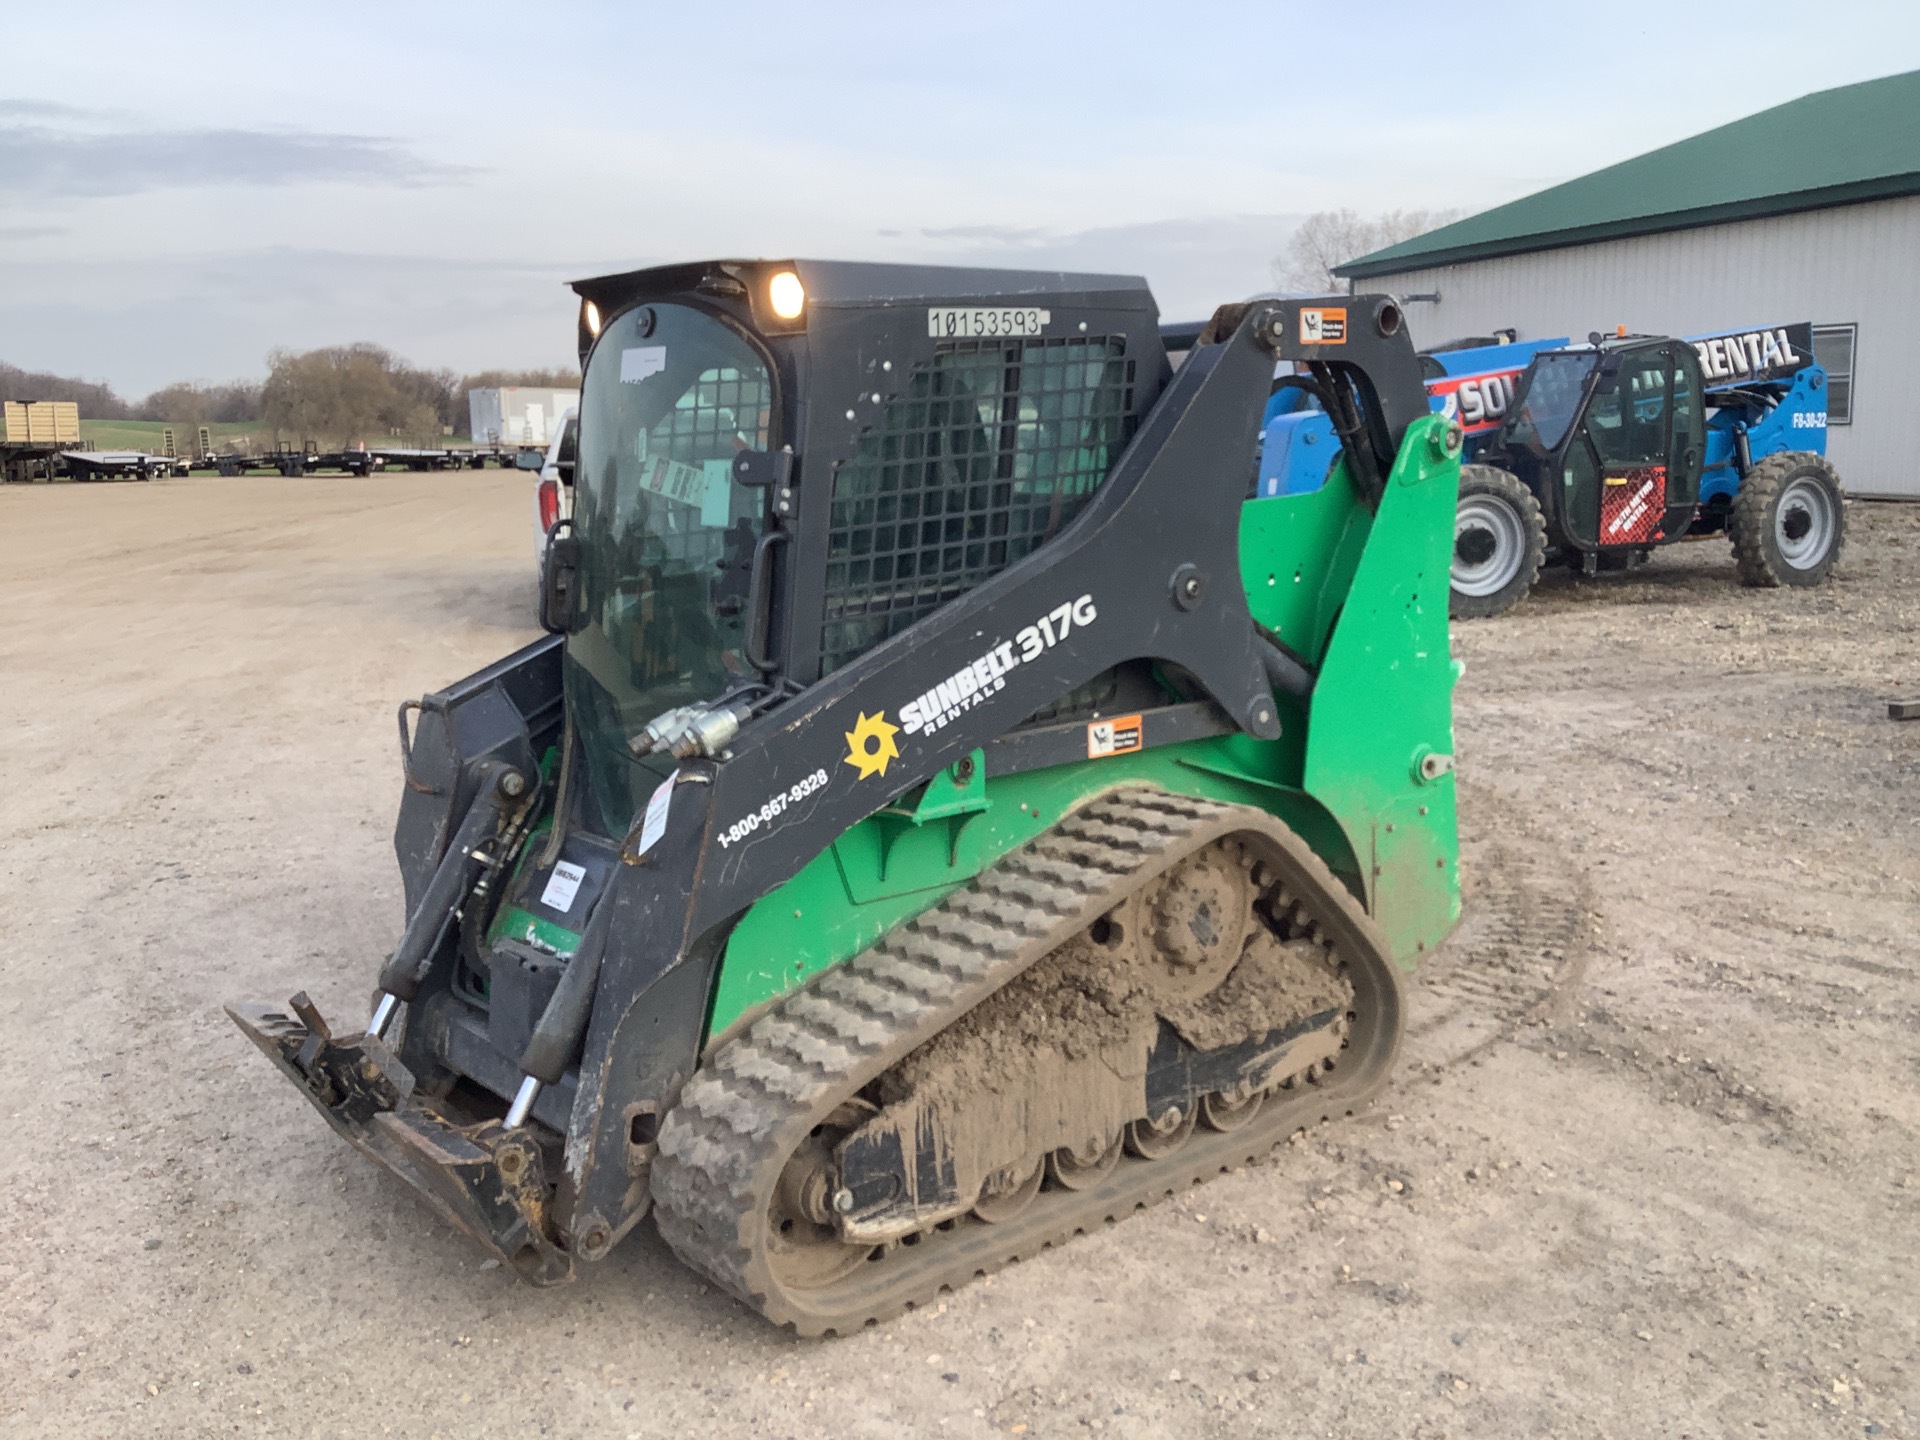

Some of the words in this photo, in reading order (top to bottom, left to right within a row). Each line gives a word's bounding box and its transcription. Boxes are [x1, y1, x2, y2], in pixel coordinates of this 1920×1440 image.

[932, 311, 1038, 337] 10153593
[1693, 329, 1800, 379] RENTAL
[1793, 412, 1827, 428] F8-30-22
[1608, 505, 1632, 535] SOUTH
[1629, 480, 1654, 509] METRO
[1622, 502, 1649, 532] RENTAL
[1015, 594, 1098, 663] 317G
[899, 639, 1014, 735] SUNBELT
[923, 676, 1006, 737] RENTALS
[717, 768, 829, 849] 1-800-667-9328
